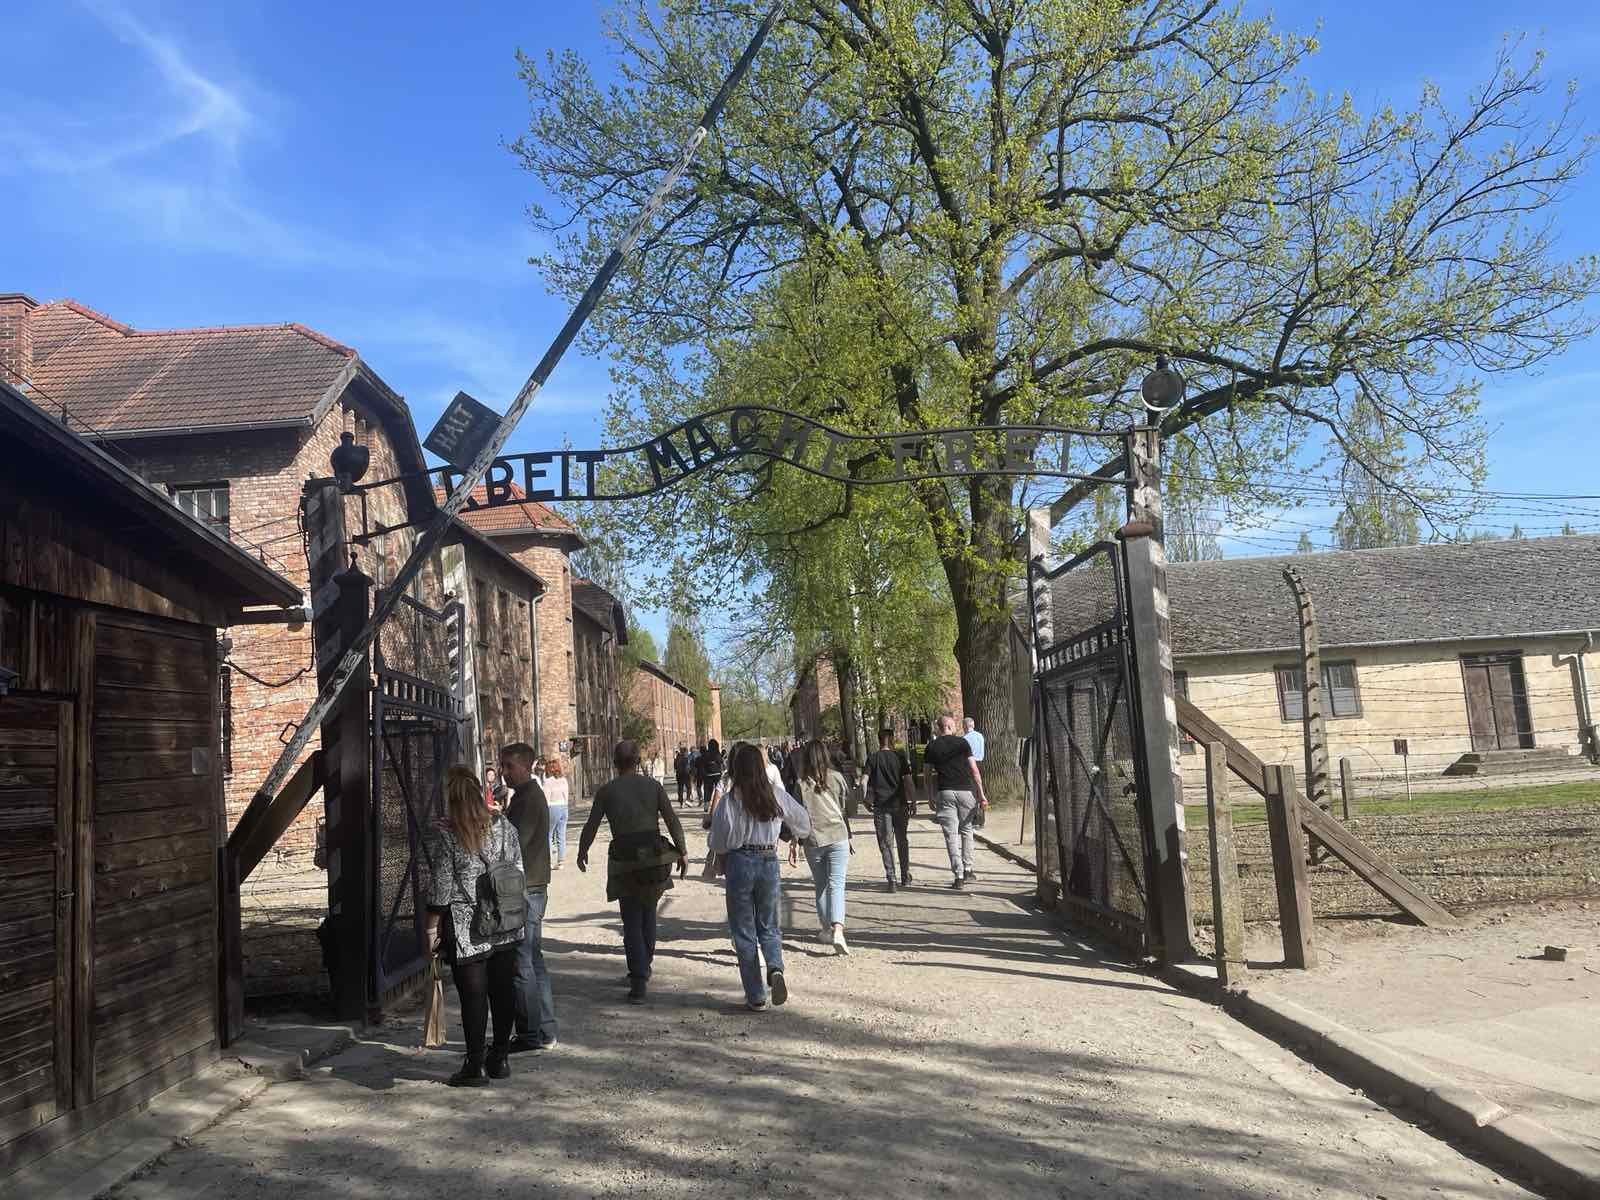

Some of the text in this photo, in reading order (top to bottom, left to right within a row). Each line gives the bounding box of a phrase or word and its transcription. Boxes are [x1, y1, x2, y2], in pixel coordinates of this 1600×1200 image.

[433, 403, 473, 453] HALT
[646, 408, 847, 487] MACHT
[894, 430, 1071, 479] FREI
